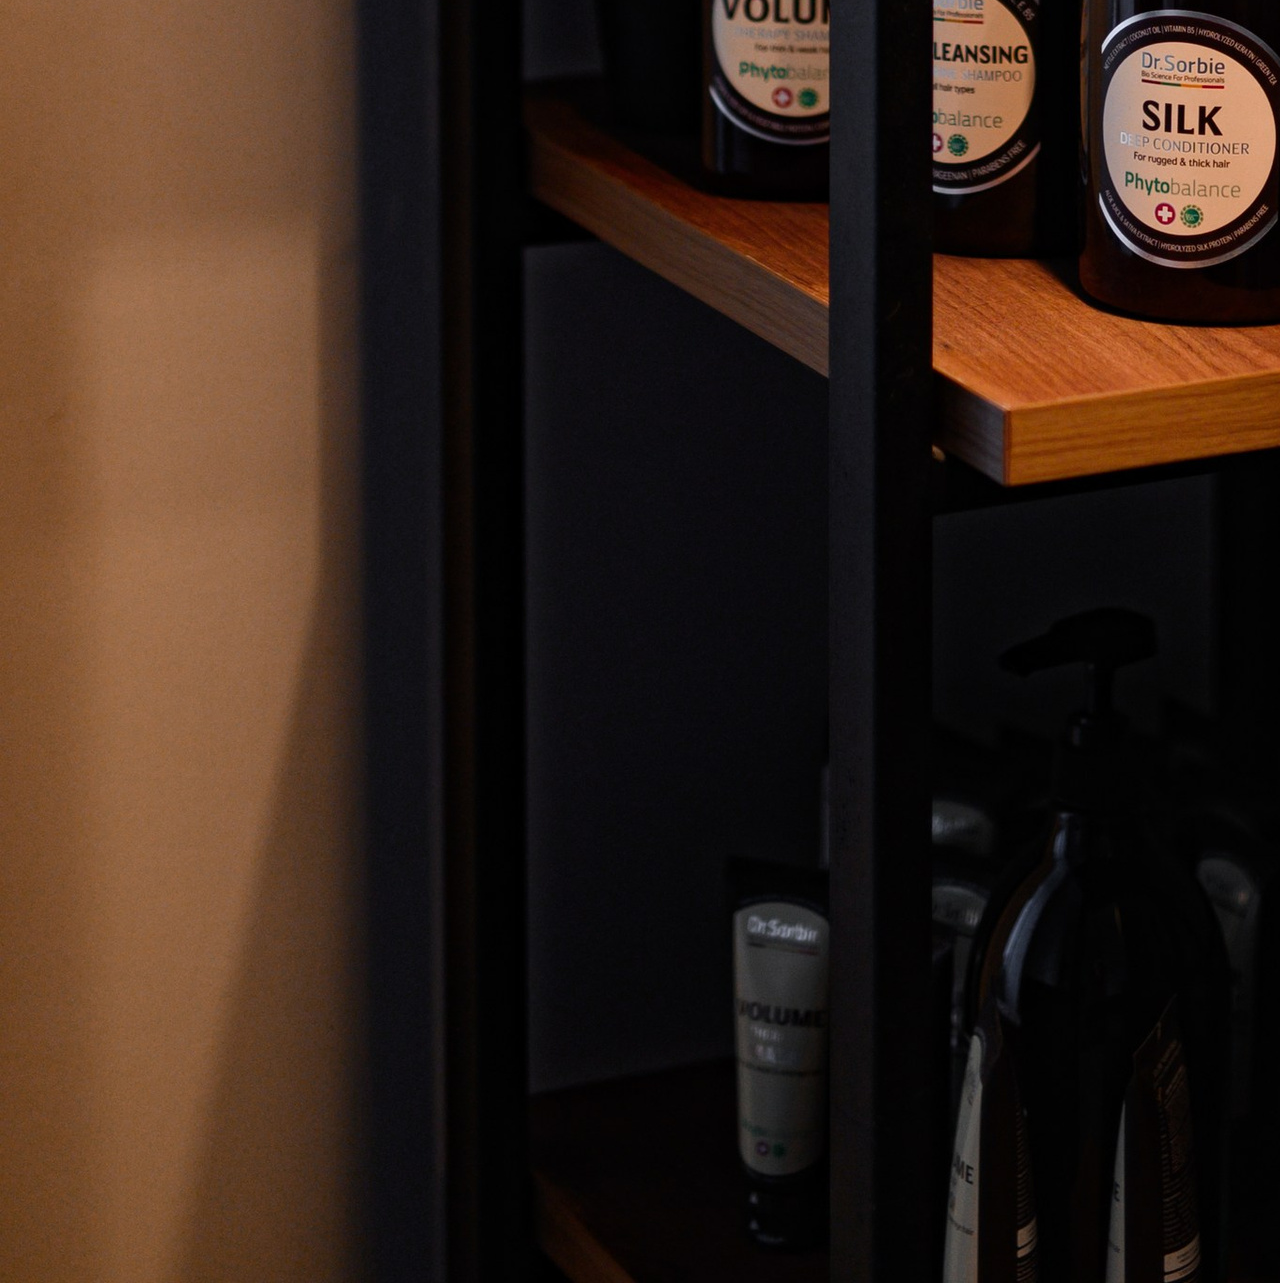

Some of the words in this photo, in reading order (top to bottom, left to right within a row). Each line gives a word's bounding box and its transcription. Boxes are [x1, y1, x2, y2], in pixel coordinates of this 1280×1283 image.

[933, 42, 1028, 64] LEANSING
[1129, 27, 1153, 43] COCONUT
[1164, 25, 1187, 34] VITAMIN
[1198, 28, 1236, 47] HYDROLYZED
[1234, 41, 1257, 62] KERATIN
[1141, 51, 1225, 74] Dr.Sorbie
[1151, 71, 1172, 80] Science
[1184, 75, 1225, 84] Professionals
[955, 85, 975, 95] types
[1142, 99, 1223, 136] SILK
[1120, 131, 1150, 148] DEEP
[1153, 137, 1250, 155] CONDITIONER
[1133, 151, 1146, 162] For
[1148, 155, 1178, 166] rugged
[1179, 157, 1187, 167] &
[1189, 159, 1211, 168] thick
[1213, 159, 1231, 169] hair
[1125, 171, 1241, 198] Phytobalance
[1135, 230, 1158, 248] EXTRACT
[1161, 242, 1196, 253] HYDROLYZED
[1196, 243, 1210, 253] SILK
[1209, 235, 1233, 249] PROTEIN
